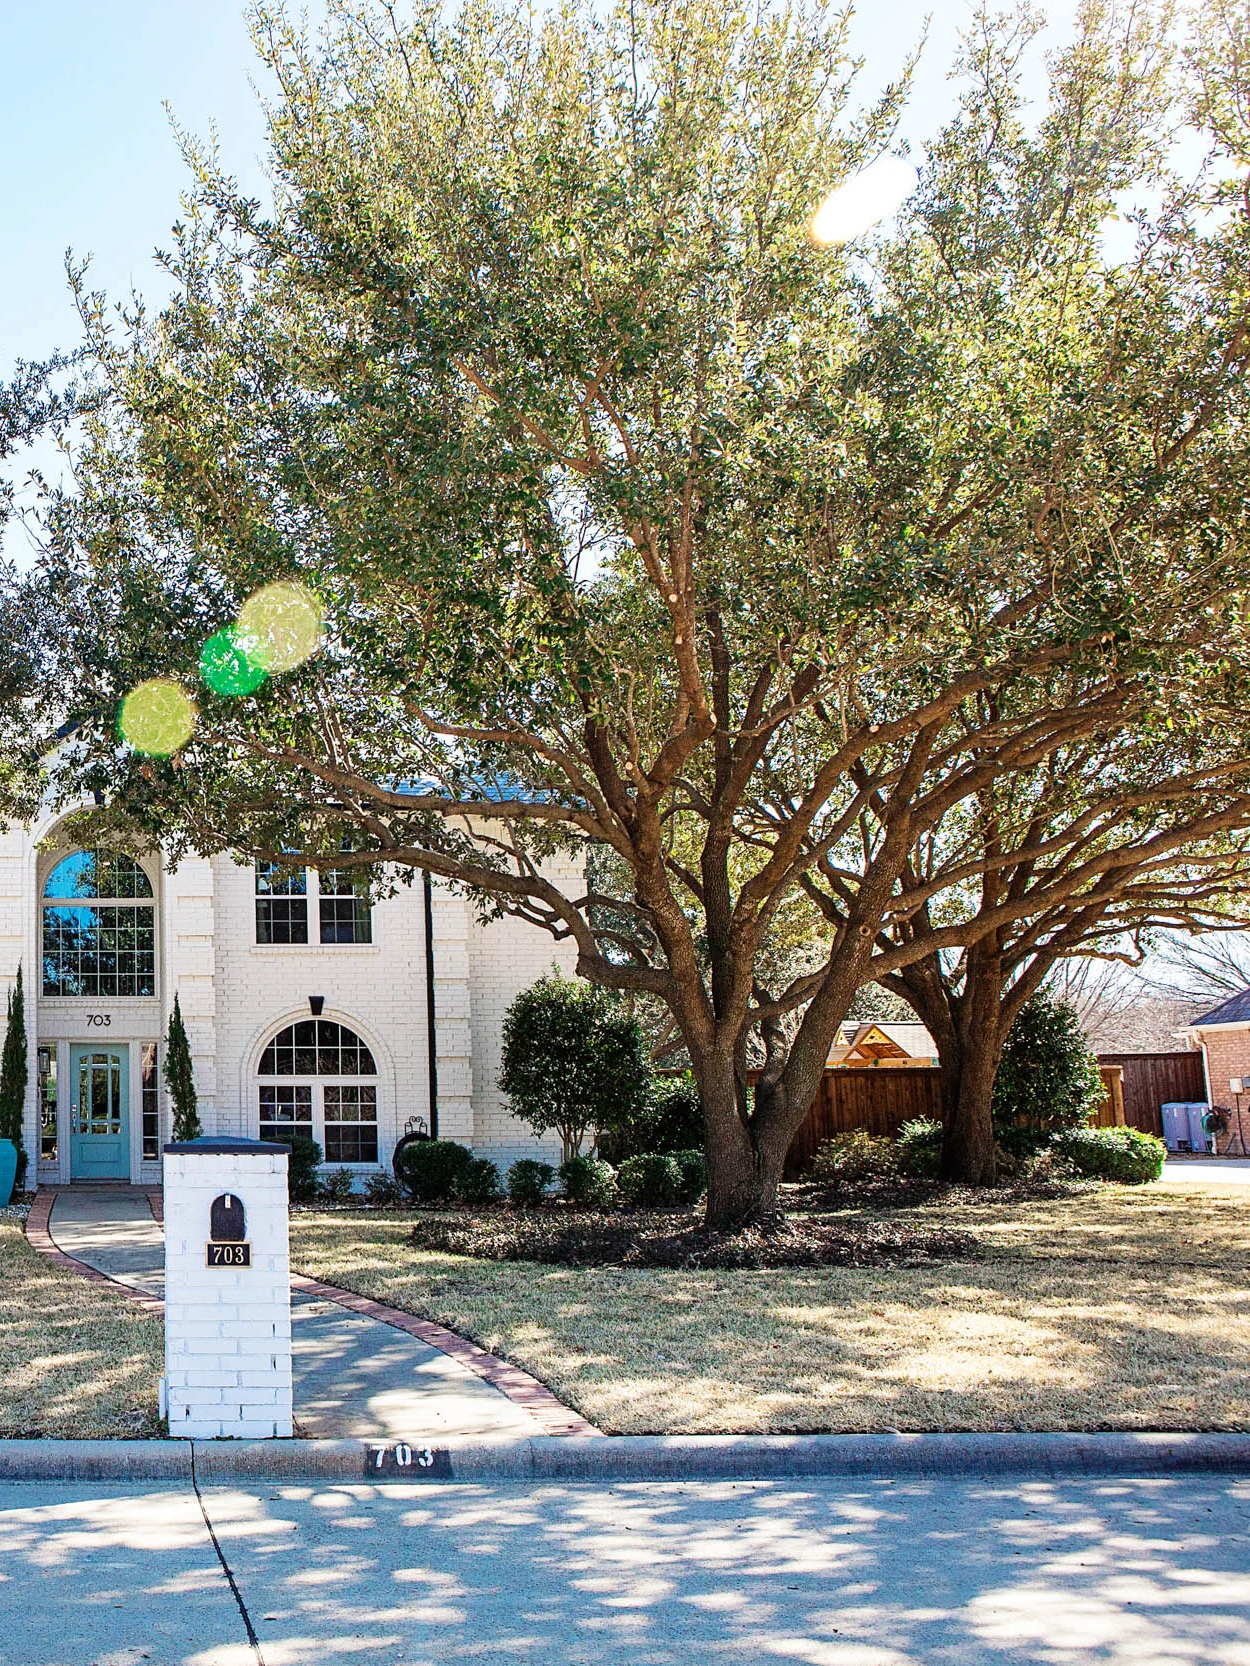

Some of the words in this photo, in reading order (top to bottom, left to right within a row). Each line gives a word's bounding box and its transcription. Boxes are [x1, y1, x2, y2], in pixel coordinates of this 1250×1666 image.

[86, 1014, 111, 1027] 703
[213, 1246, 244, 1264] 703
[371, 1444, 434, 1468] 703
